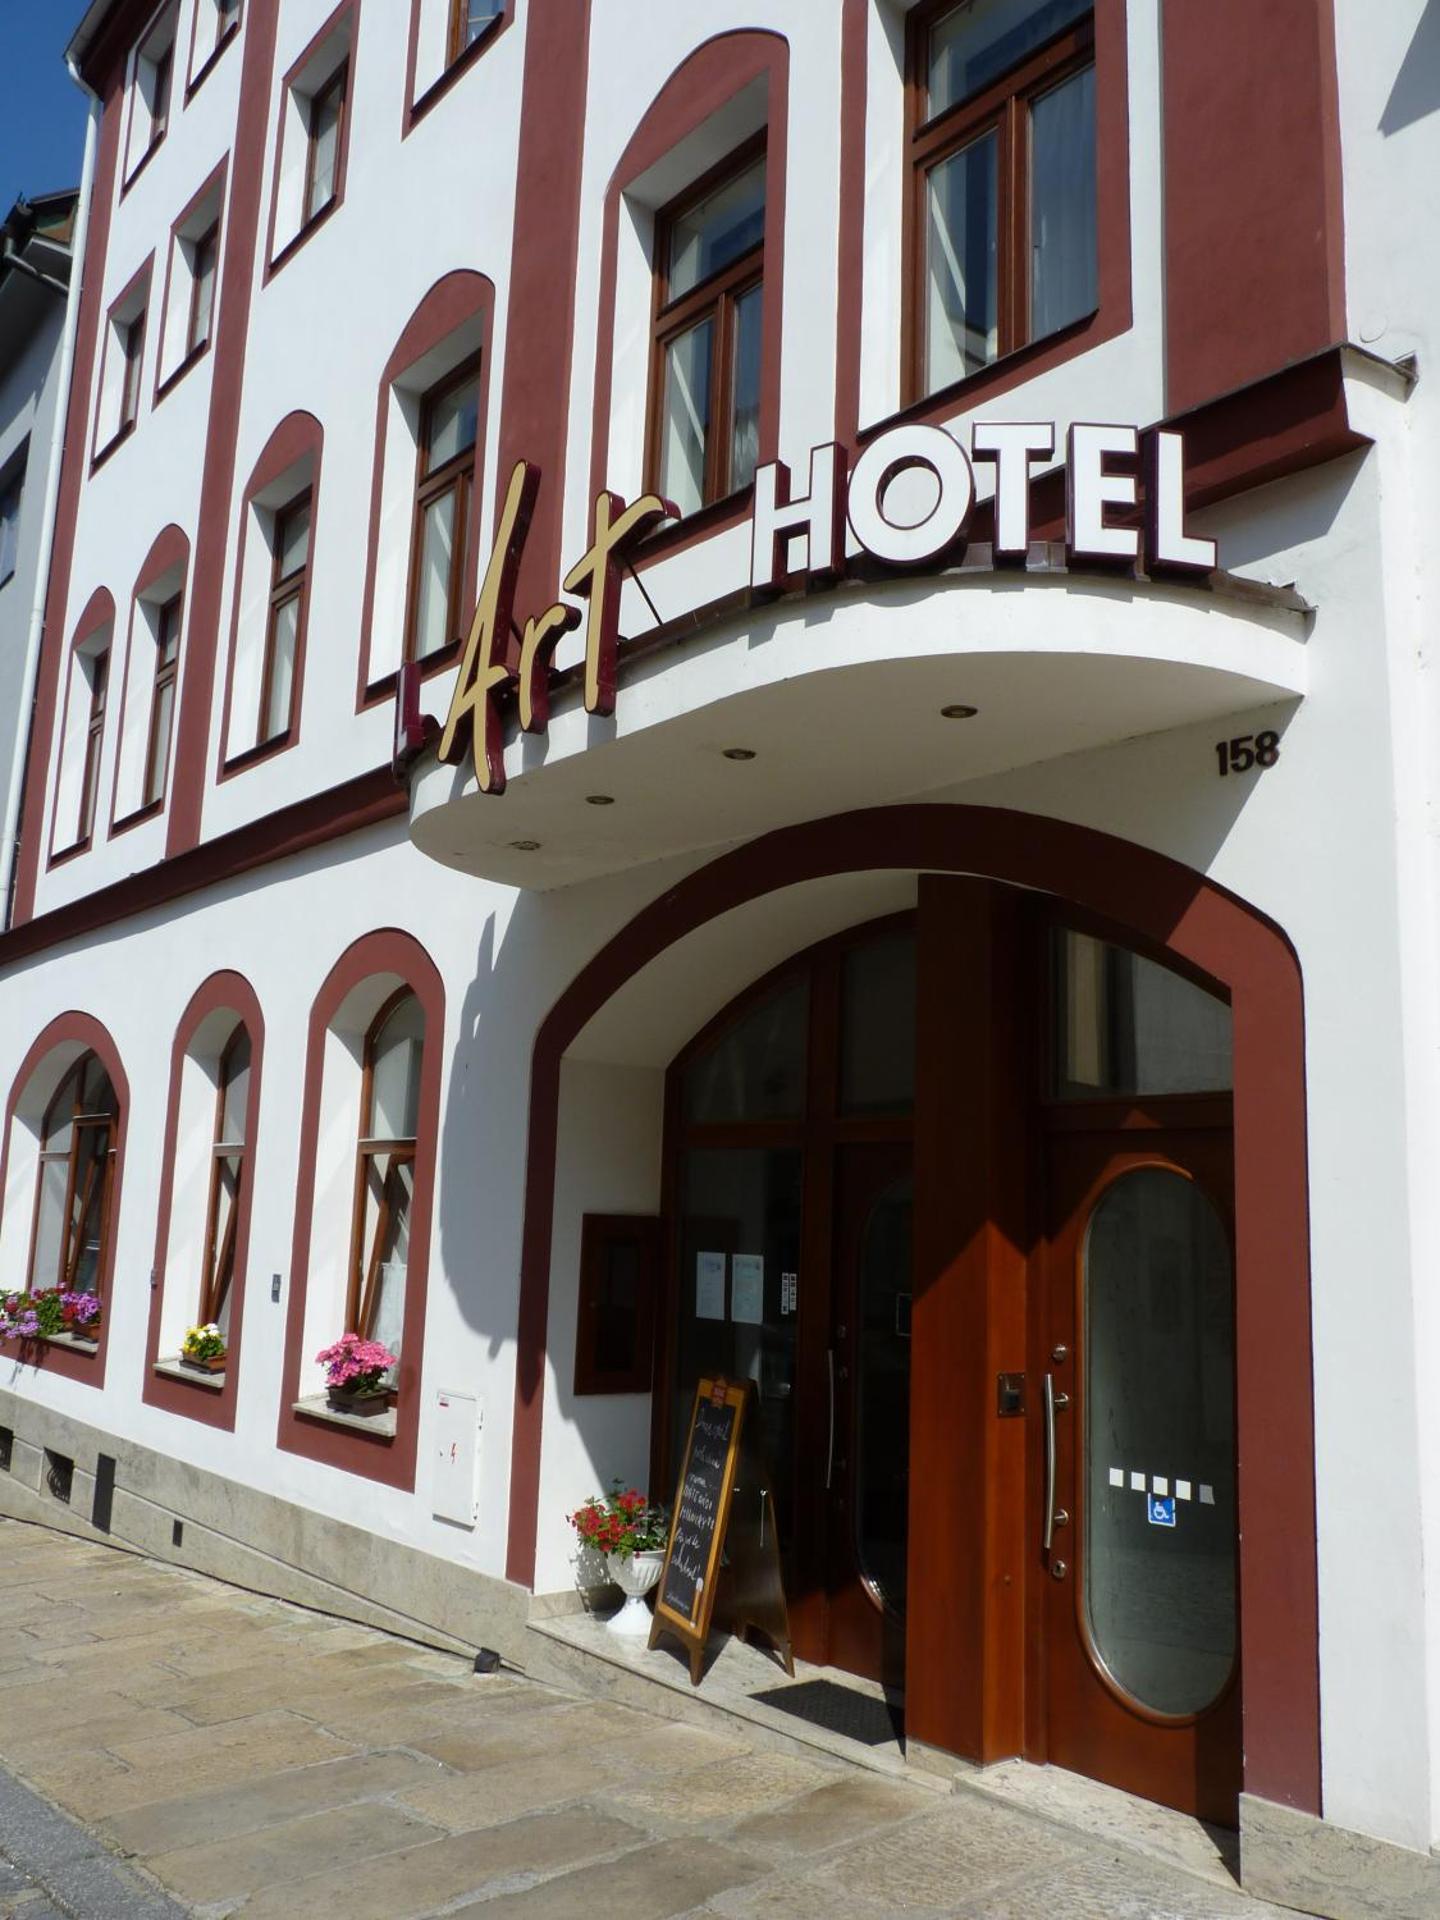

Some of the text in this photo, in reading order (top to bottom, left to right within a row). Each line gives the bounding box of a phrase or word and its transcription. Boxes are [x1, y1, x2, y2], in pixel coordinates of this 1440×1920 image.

[438, 422, 1217, 795] Art HOTEL
[1216, 730, 1280, 776] 158
